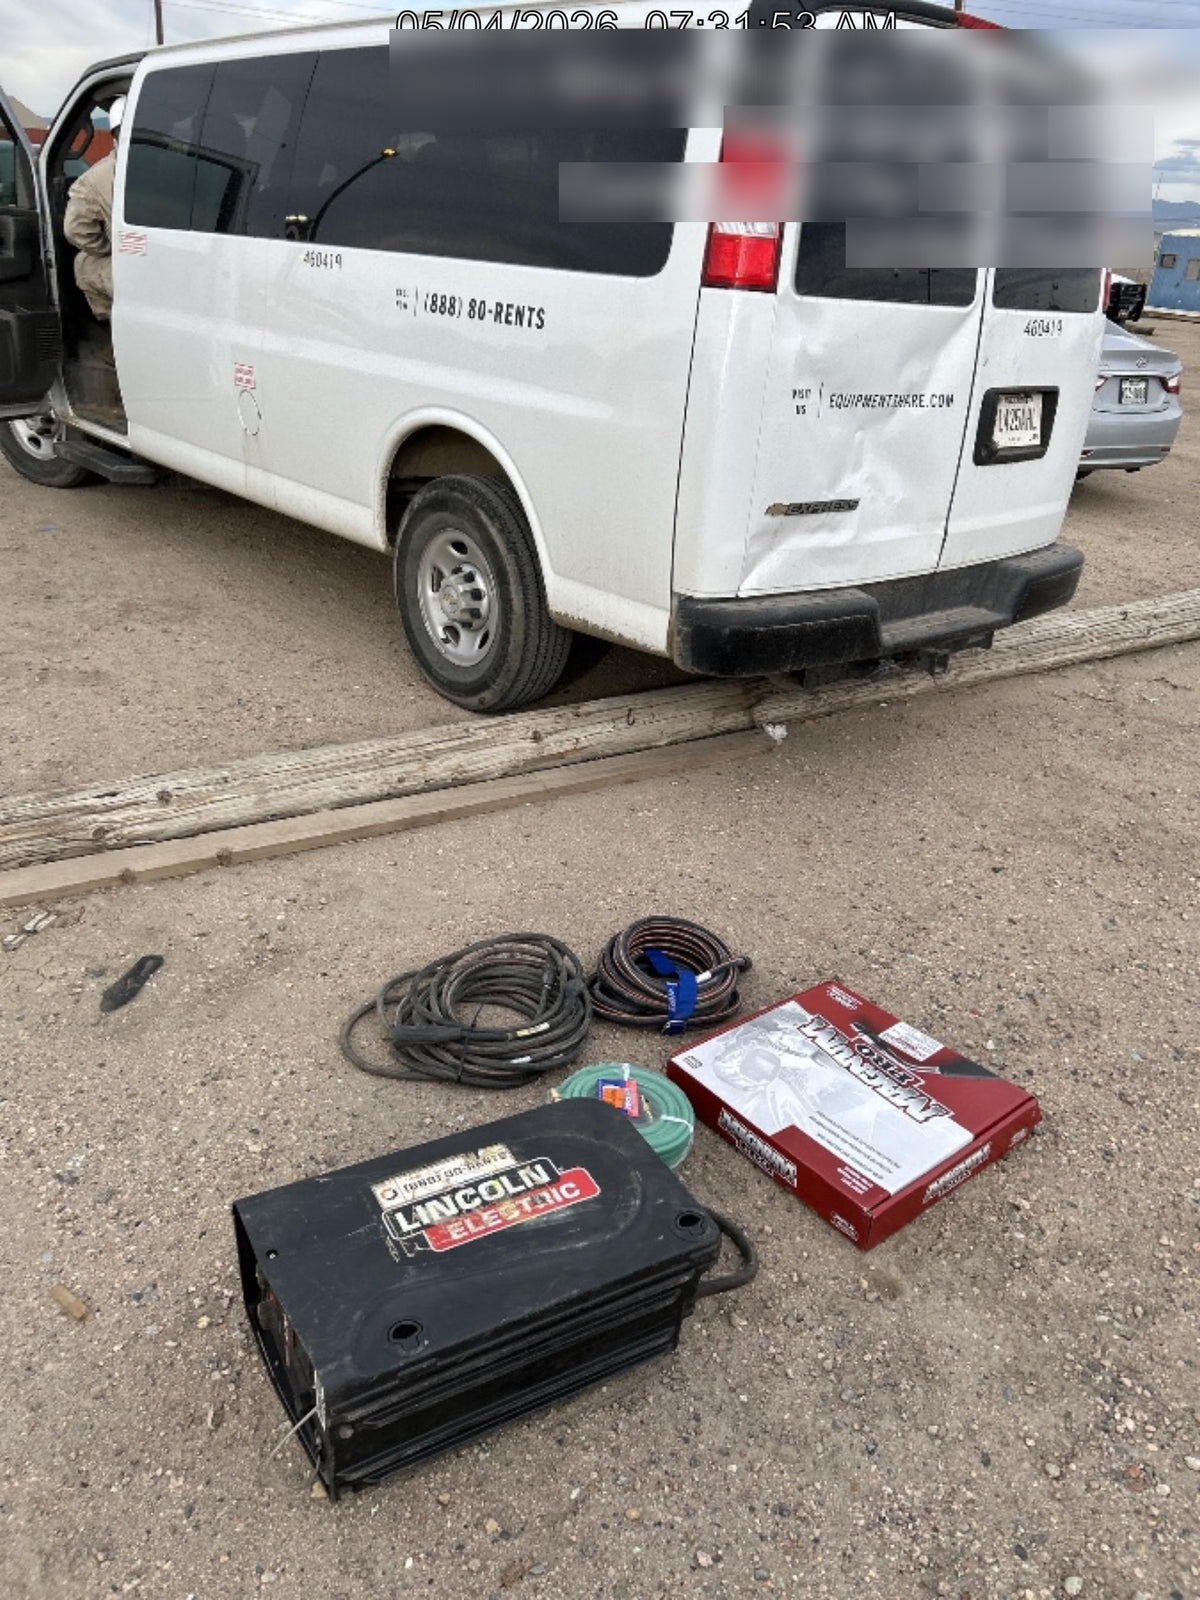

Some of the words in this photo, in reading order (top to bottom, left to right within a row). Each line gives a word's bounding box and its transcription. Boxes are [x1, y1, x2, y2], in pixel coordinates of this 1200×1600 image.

[424, 292, 463, 318] (888)
[468, 298, 546, 330] 80-RENTS
[797, 1016, 950, 1123] MAGNUM
[855, 1043, 914, 1085] PRO
[393, 1163, 551, 1232] LINCOLN
